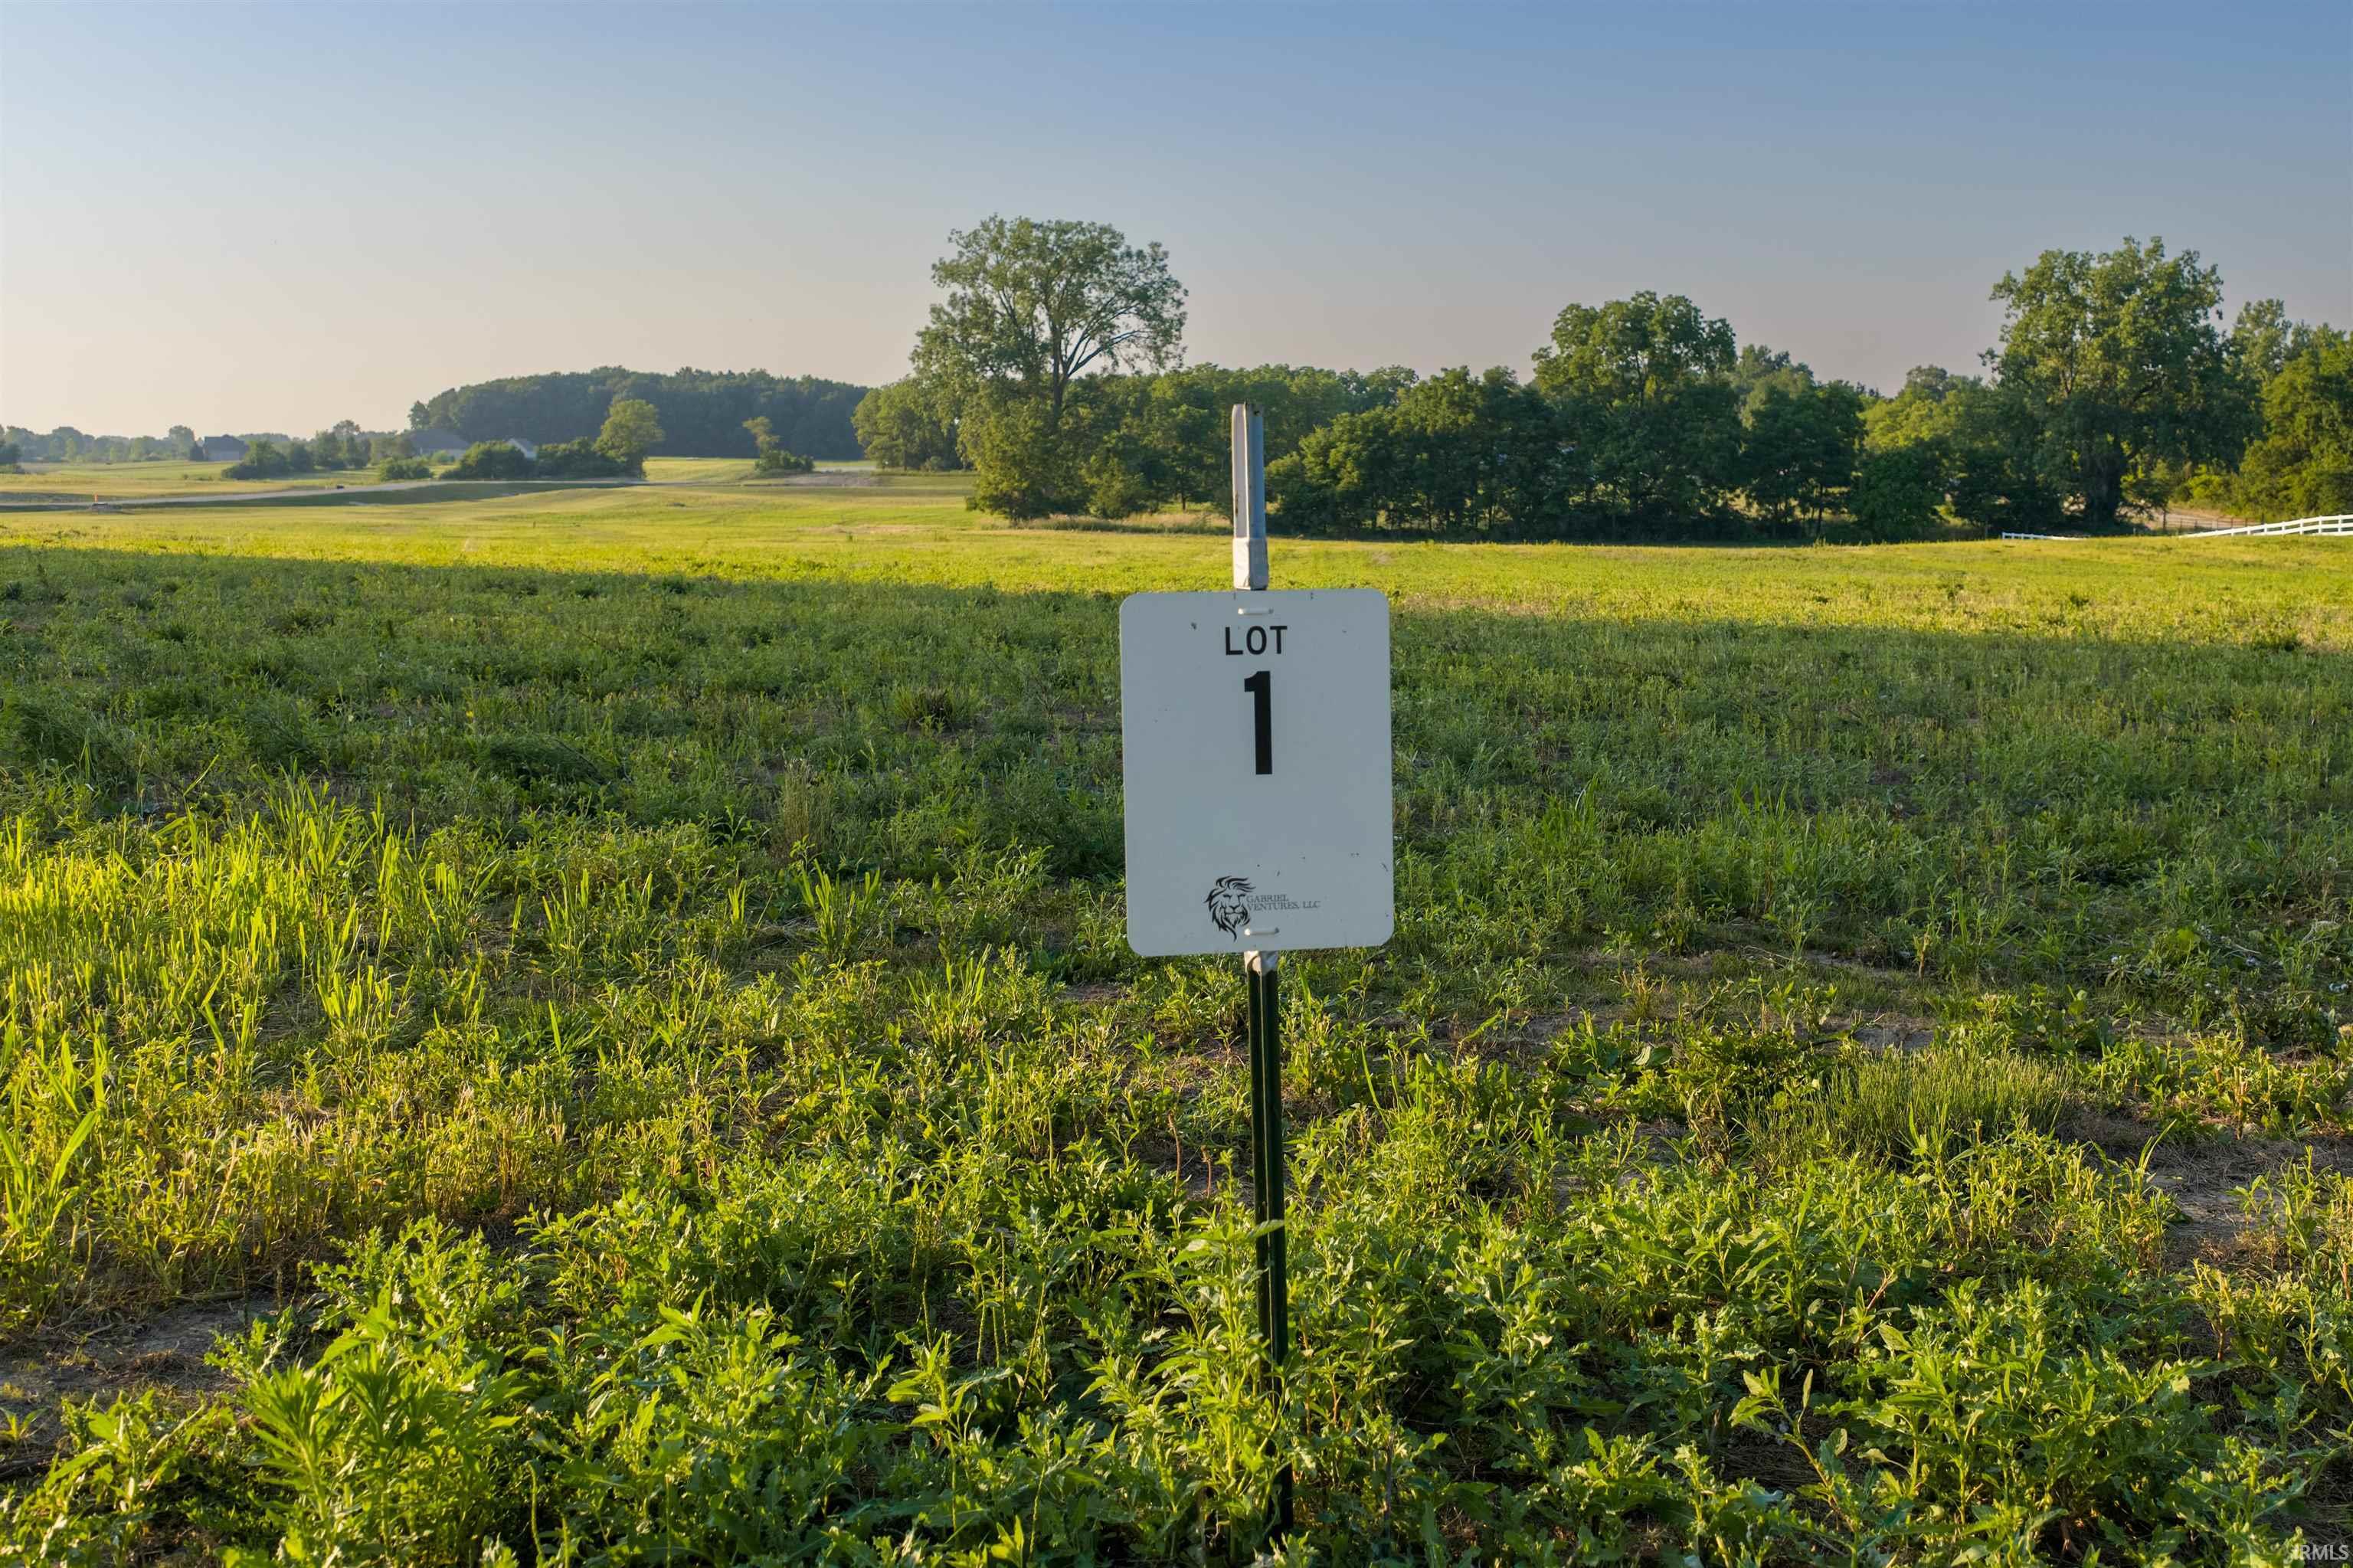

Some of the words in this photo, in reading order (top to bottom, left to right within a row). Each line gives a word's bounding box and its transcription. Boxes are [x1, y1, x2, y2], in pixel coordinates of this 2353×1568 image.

[1225, 625, 1288, 656] LOT
[1244, 670, 1273, 775] 1
[1246, 894, 1288, 903] GABRIEL
[1302, 900, 1321, 908] LLC
